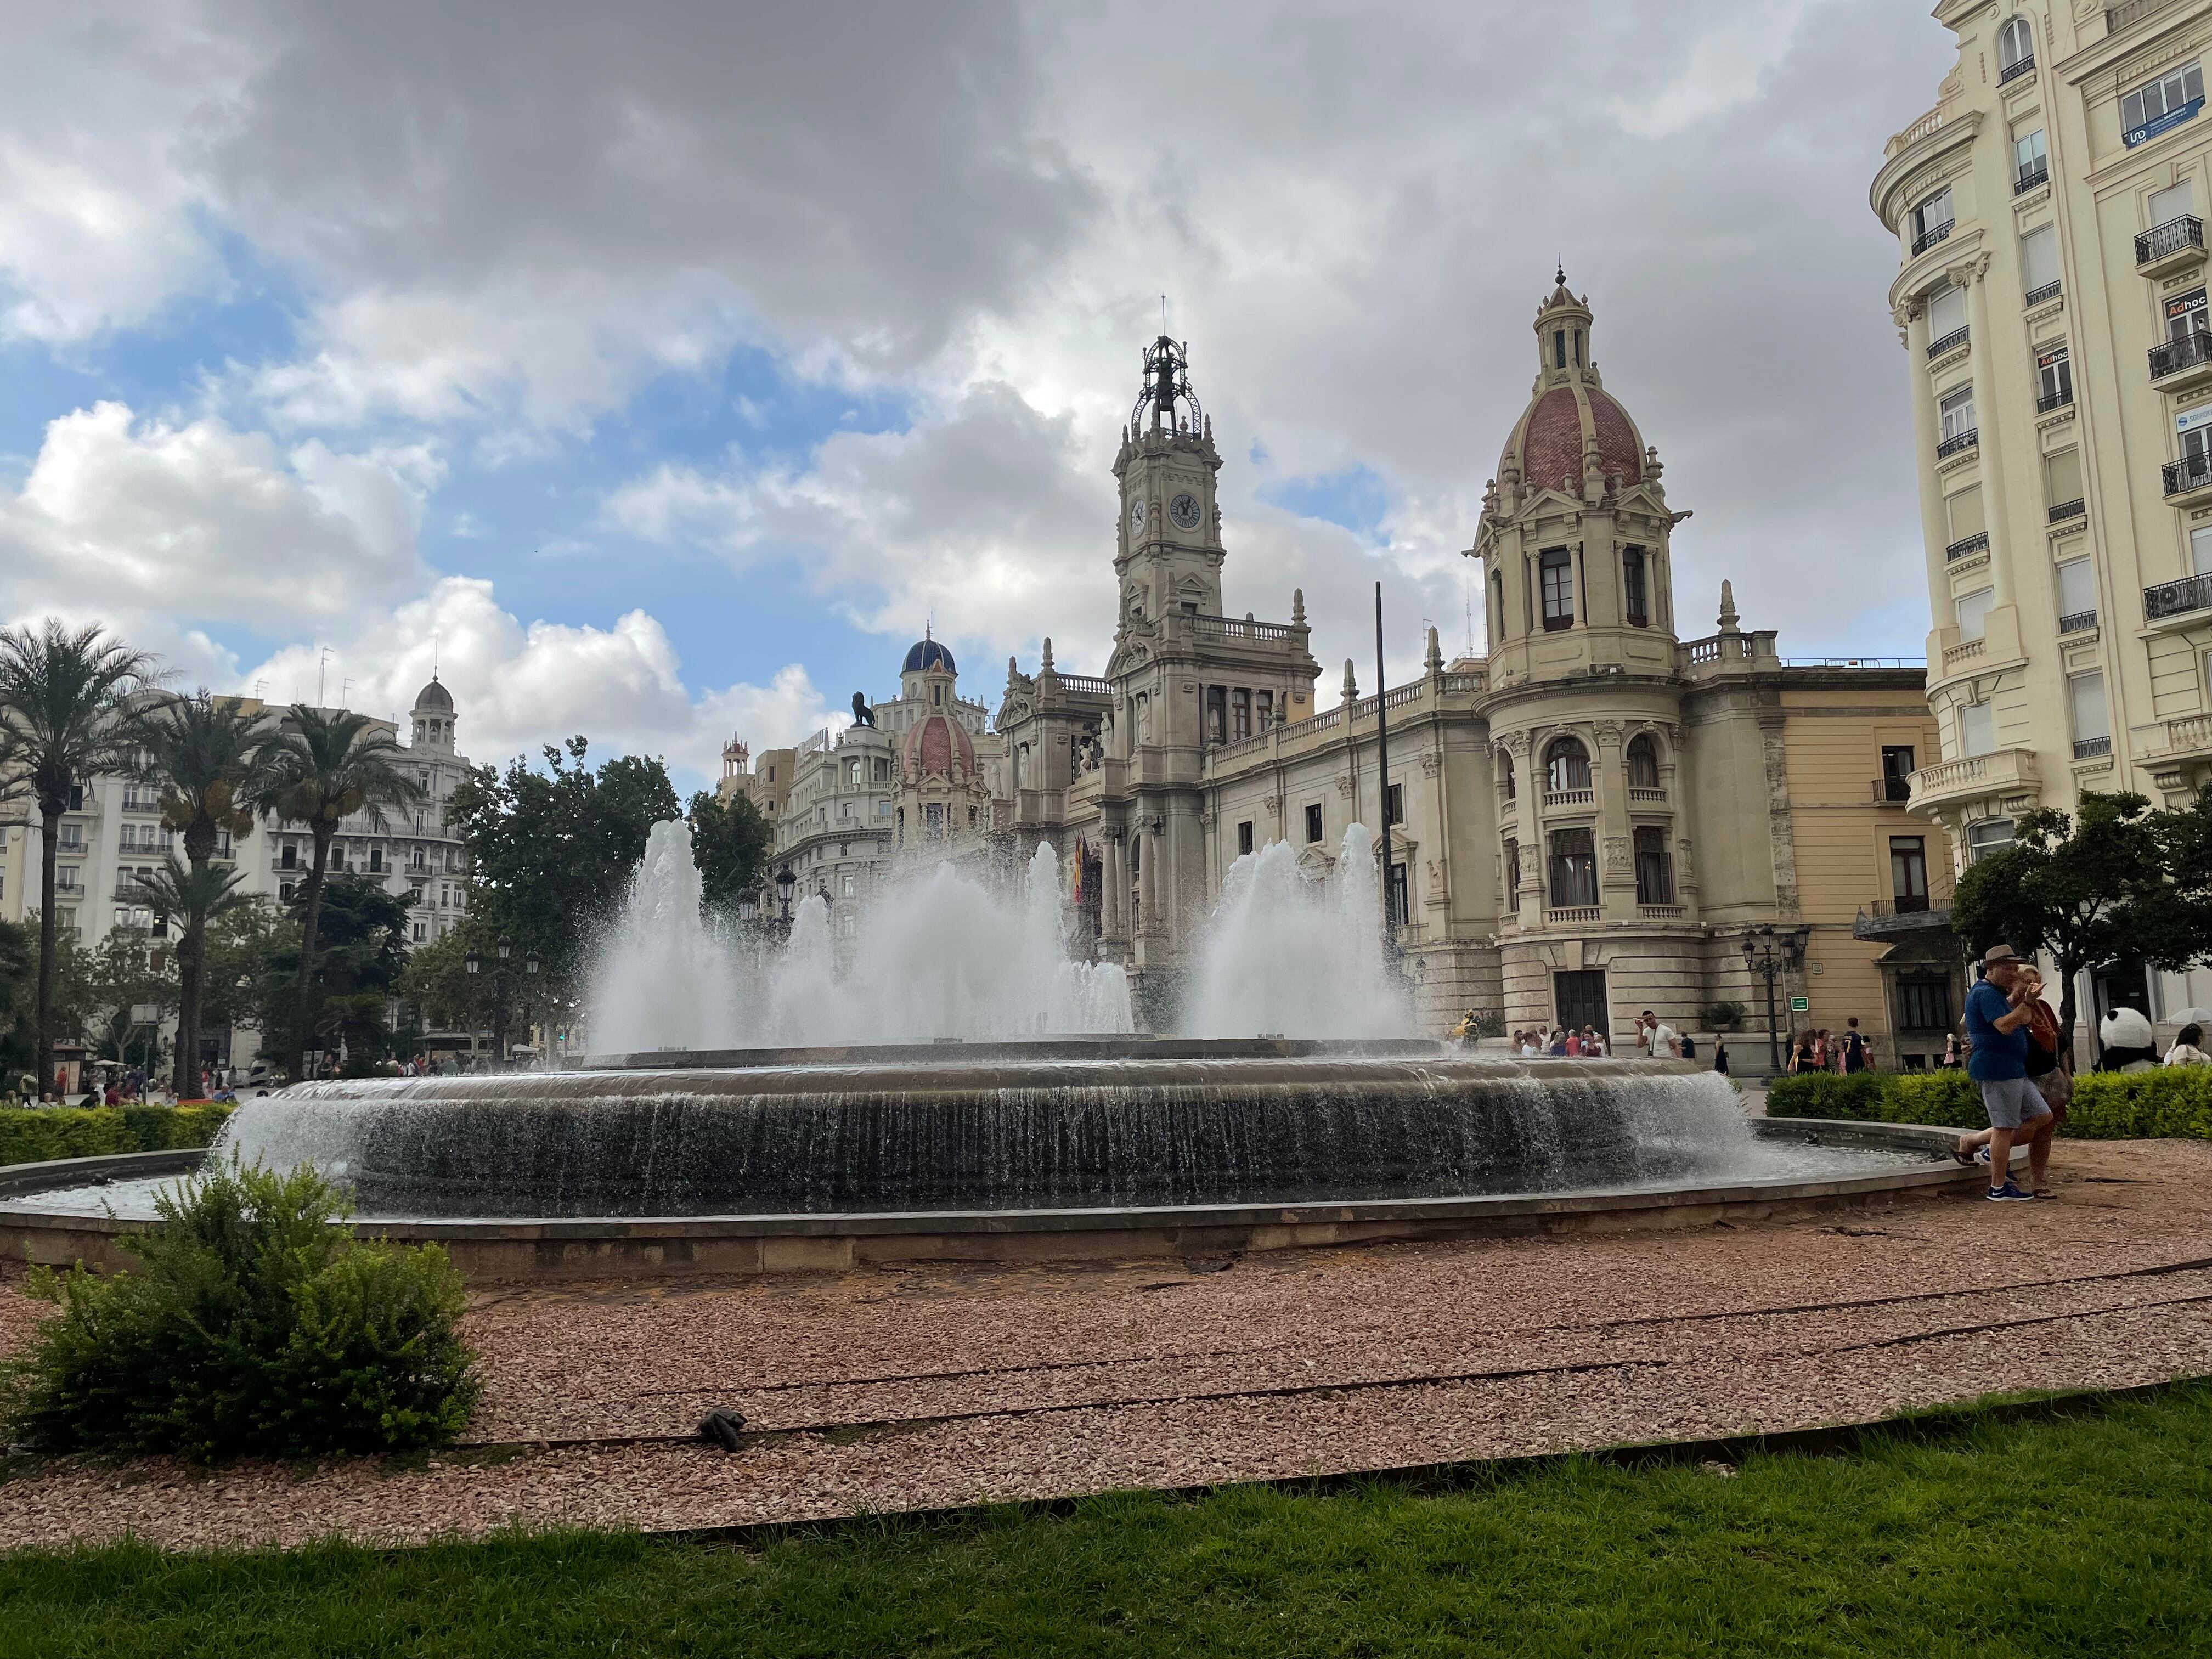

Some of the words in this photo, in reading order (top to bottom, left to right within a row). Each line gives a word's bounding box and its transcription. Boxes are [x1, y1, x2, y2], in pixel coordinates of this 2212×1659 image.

[2169, 296, 2206, 317] Adhoc
[2041, 351, 2068, 366] Adhoc
[1844, 1039, 1852, 1053] 7
